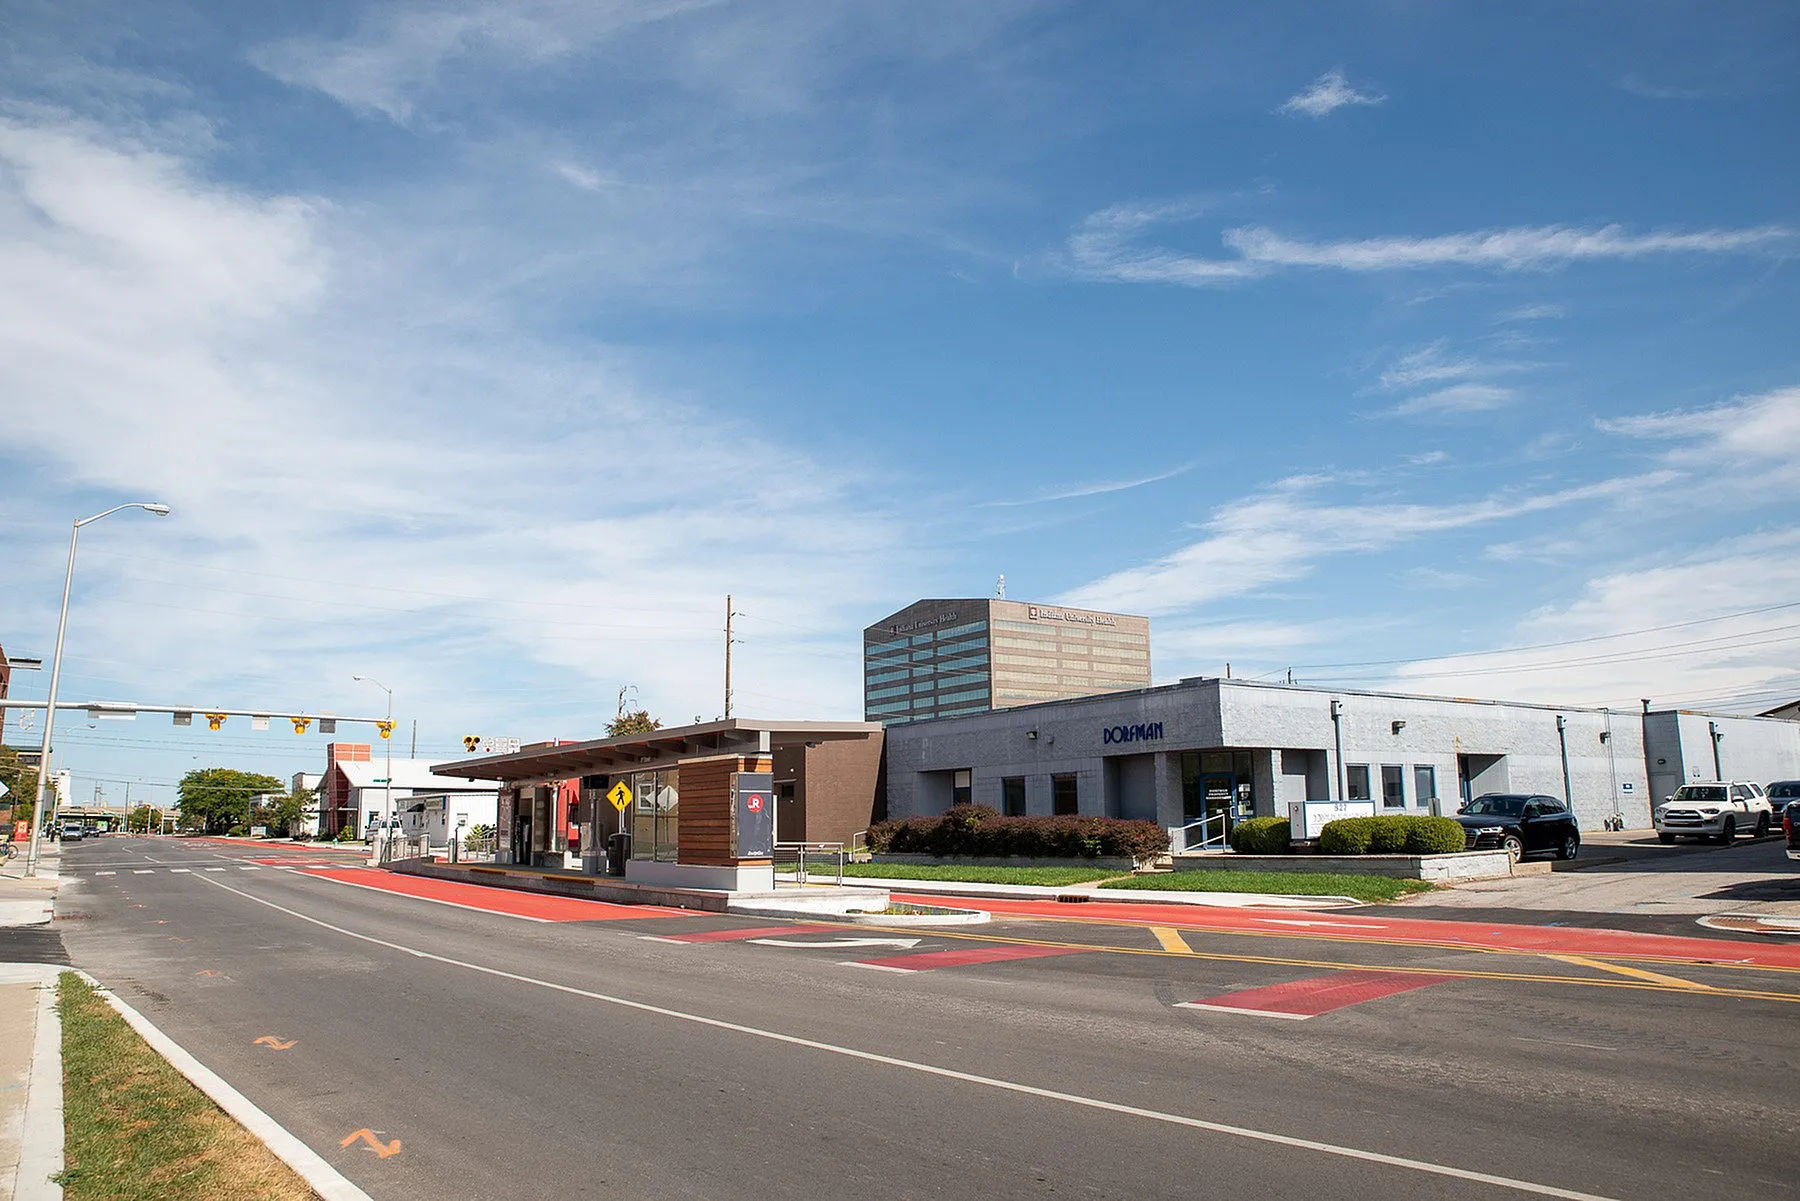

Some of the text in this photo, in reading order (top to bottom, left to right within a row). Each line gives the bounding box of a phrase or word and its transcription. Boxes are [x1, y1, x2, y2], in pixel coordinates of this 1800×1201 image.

[1040, 609, 1116, 626] Indiana University Health
[1103, 721, 1164, 745] DORFMAN
